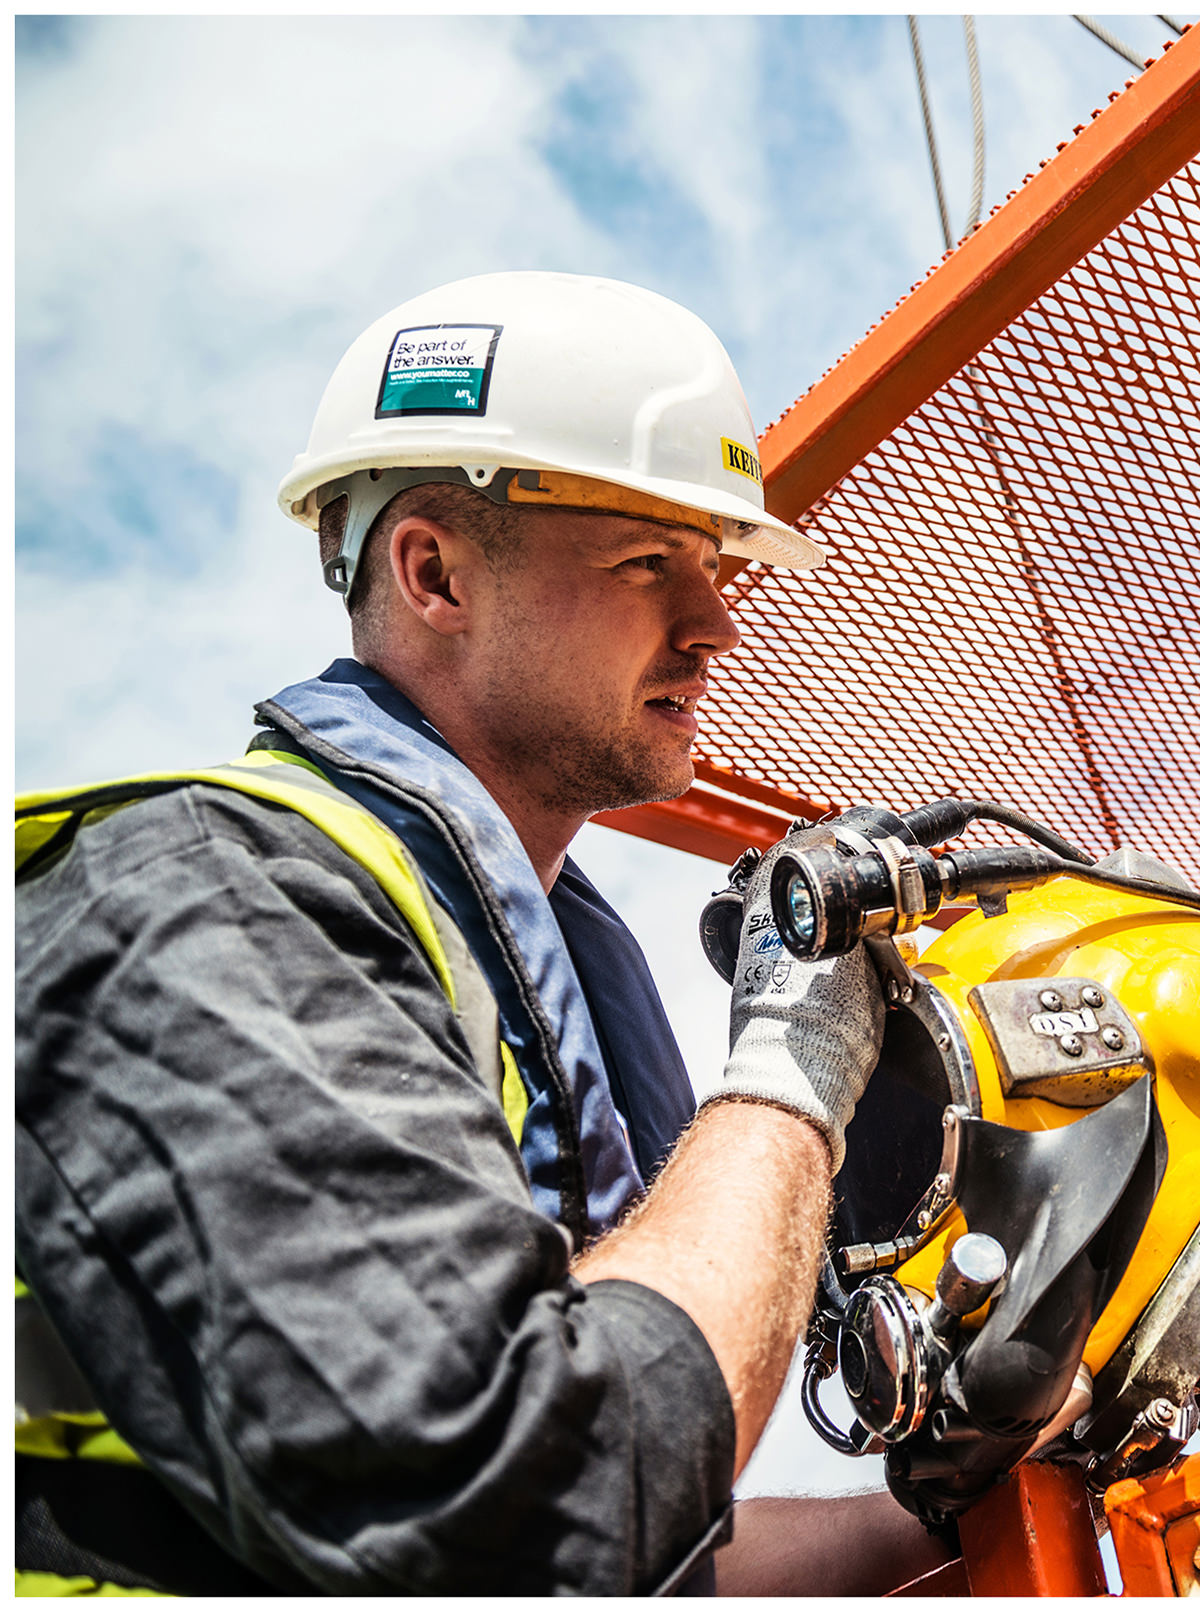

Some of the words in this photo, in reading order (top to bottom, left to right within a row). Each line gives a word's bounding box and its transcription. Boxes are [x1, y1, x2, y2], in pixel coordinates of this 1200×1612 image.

[397, 342, 415, 354] Be
[417, 340, 447, 354] part
[450, 339, 468, 351] of
[394, 356, 414, 369] the
[417, 354, 474, 366] answer.
